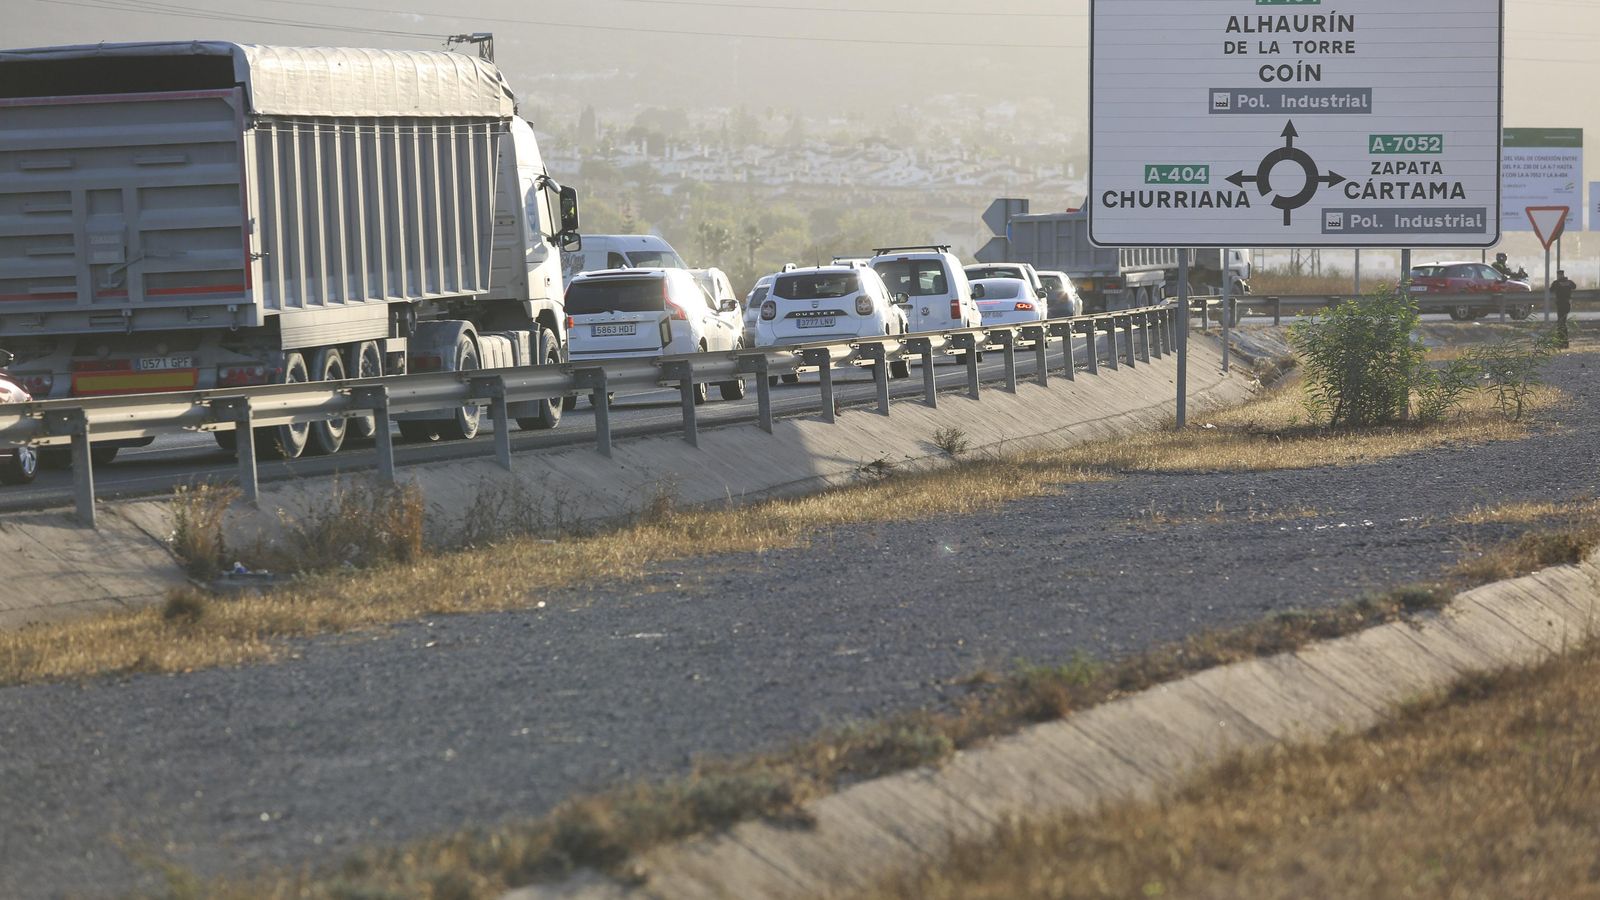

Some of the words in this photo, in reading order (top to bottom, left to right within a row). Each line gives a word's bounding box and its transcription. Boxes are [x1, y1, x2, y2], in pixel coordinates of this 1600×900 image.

[1225, 10, 1355, 33] ALHAURÍN
[1224, 41, 1247, 54] DE
[1258, 41, 1280, 54] LA
[1293, 40, 1355, 54] TORRE
[1258, 60, 1321, 82] COÍN
[1237, 94, 1270, 108] Pol.
[1281, 94, 1368, 108] Industrial
[1371, 137, 1441, 151] A-7052
[1147, 167, 1206, 182] A-404
[1371, 161, 1443, 175] ZAPATA
[1344, 178, 1466, 200] CÁRTAMA
[1102, 190, 1250, 208] CHURRIANA
[1351, 214, 1384, 228] Pol.
[1395, 213, 1482, 228] Industrial
[596, 326, 616, 334] 5863
[142, 358, 167, 369] 0571
